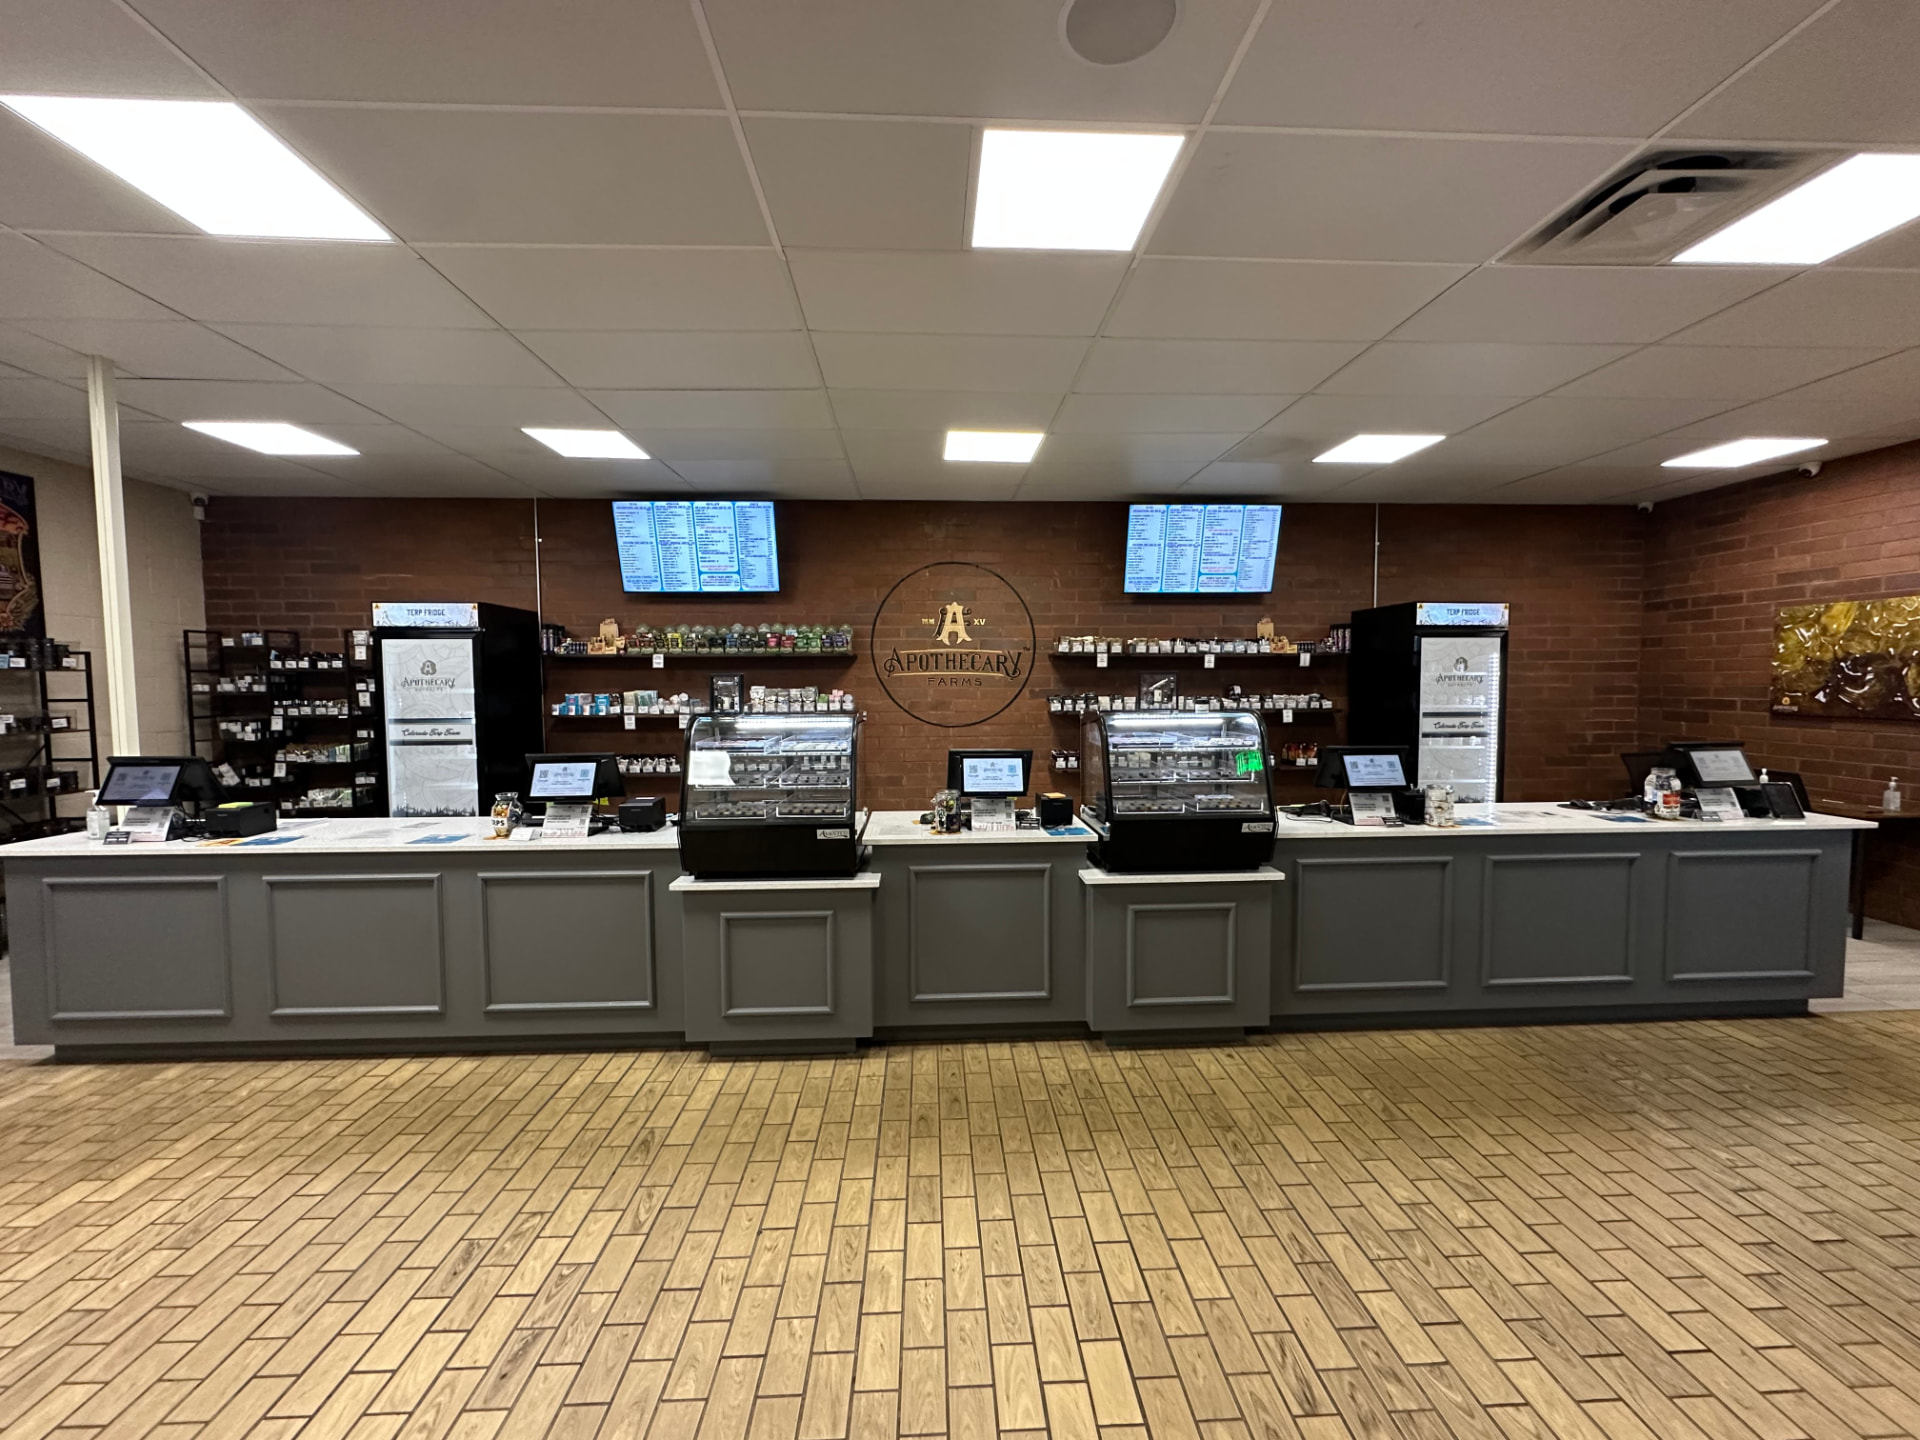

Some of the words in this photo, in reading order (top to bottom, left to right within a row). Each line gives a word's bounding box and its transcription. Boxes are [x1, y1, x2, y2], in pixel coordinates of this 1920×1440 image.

[973, 618, 986, 626] XV
[883, 647, 1022, 681] APOTHECARY
[401, 677, 456, 688] APOTHECARY
[927, 677, 983, 687] FARMS
[1435, 673, 1484, 684] APOTHECARY
[401, 728, 428, 736] Colorado
